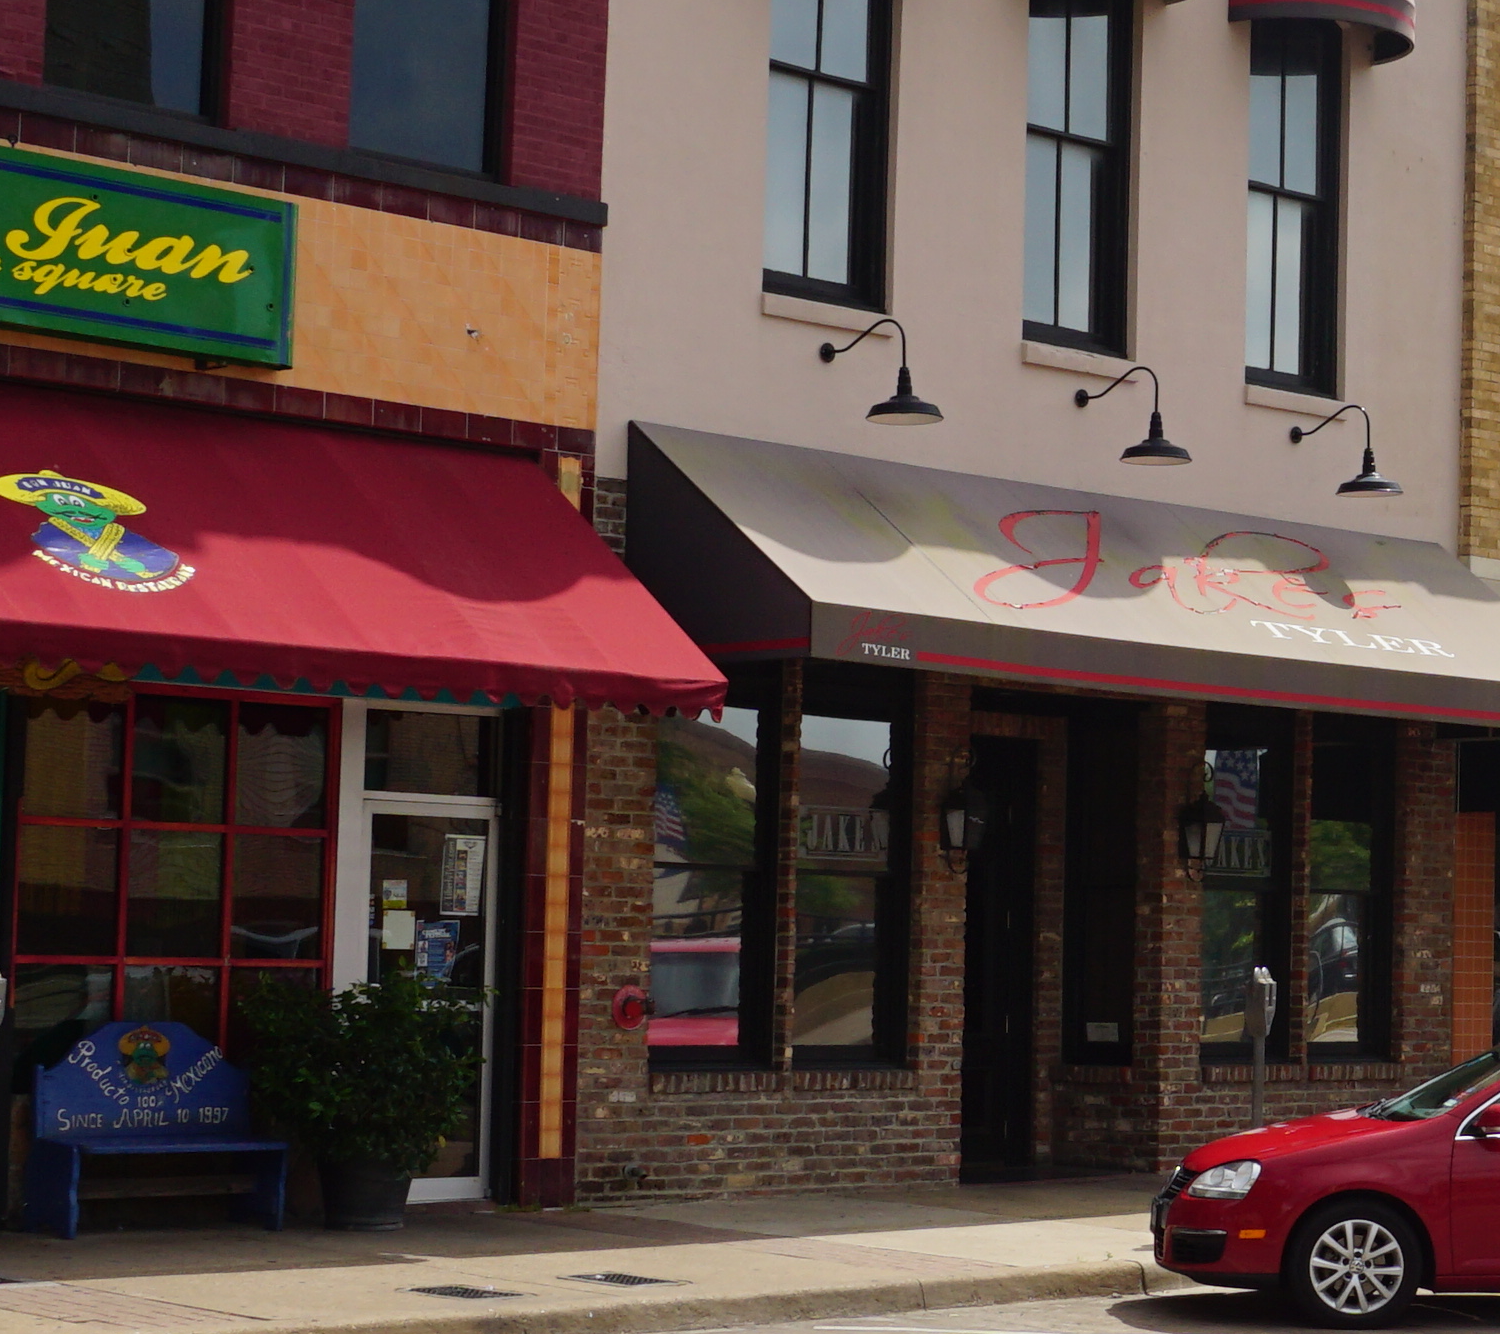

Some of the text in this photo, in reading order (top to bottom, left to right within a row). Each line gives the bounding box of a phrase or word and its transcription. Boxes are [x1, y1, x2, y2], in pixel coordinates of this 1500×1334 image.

[5, 197, 256, 285] Juan
[11, 257, 168, 303] square
[52, 480, 92, 496] JUAN
[31, 549, 114, 589] MEXICAN
[861, 642, 911, 660] TYLER
[1249, 619, 1456, 659] TYLER
[67, 1039, 131, 1106] Producto
[164, 1044, 225, 1105] Mexicano
[112, 1107, 170, 1129] APRIL
[176, 1107, 190, 1123] 10
